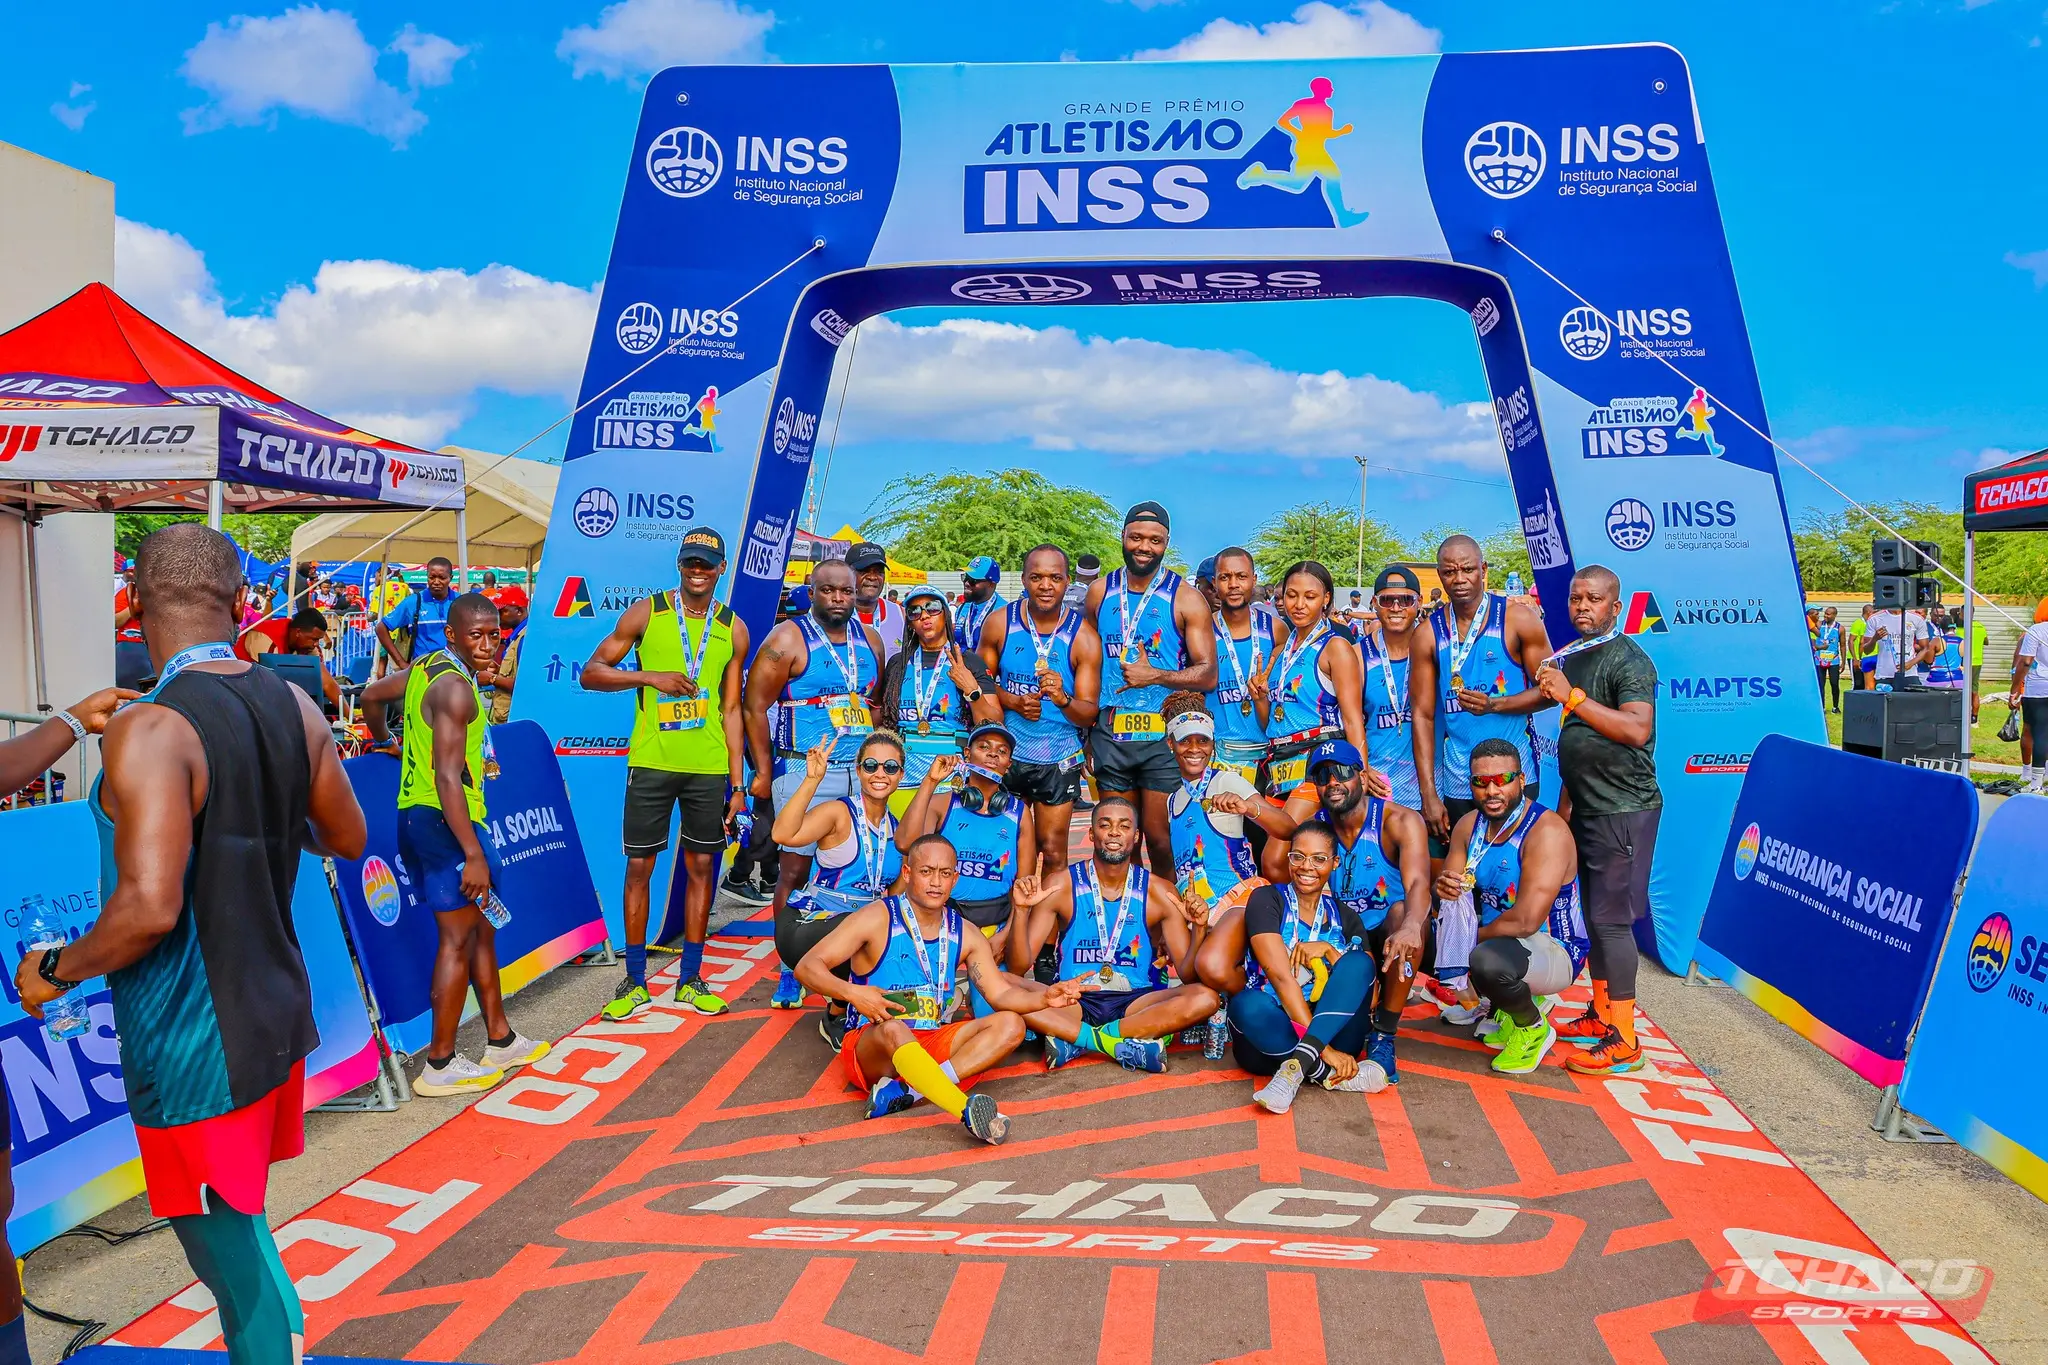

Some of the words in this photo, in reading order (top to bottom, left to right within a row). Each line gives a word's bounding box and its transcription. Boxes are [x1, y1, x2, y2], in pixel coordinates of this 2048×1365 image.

[1064, 101, 1152, 115] GRANDE
[1165, 98, 1245, 113] PRÊMIO
[985, 118, 1243, 156] ATLETISMO
[1560, 123, 1679, 164] INSS
[735, 136, 848, 175] INSS
[735, 176, 786, 191] Instituto
[790, 178, 846, 192] Nacional
[1559, 170, 1614, 181] Instituto
[1618, 168, 1678, 180] Nacional
[733, 191, 749, 202] de
[754, 192, 821, 208] Segurança
[825, 189, 863, 204] Social
[984, 165, 1209, 226] INSS
[1558, 184, 1575, 195] de
[1579, 183, 1652, 197] Segurança
[1656, 181, 1697, 192] Social
[1112, 271, 1321, 290] INSS
[670, 308, 739, 337] INSS
[1616, 308, 1692, 336] INSS
[668, 337, 699, 347] Instituto
[701, 338, 735, 349] Nacional
[1620, 340, 1654, 349] Instituto
[1656, 339, 1693, 347] Nacional
[678, 348, 720, 359] Segurança
[722, 350, 745, 360] Social
[1620, 349, 1632, 358] de
[1634, 349, 1679, 360] Segurança
[1681, 348, 1705, 357] Social
[661, 392, 688, 402] PRÊMIO
[1507, 386, 1529, 424] INSS
[1647, 397, 1676, 406] PRÊMIO
[604, 399, 688, 417] ATLETISMO
[1587, 406, 1678, 425] ATLETISMO
[47, 425, 195, 446] TCHACO
[601, 421, 675, 448] INSS
[792, 410, 817, 442] INSS
[1588, 429, 1668, 455] INSS
[237, 427, 377, 485] TCHACO
[409, 464, 458, 483] TCHACO
[625, 493, 695, 521] INSS
[1662, 500, 1736, 528] INSS
[625, 522, 656, 531] Instituto
[658, 523, 694, 533] Nacional
[625, 531, 636, 539] de
[638, 531, 679, 542] Segurança
[1664, 532, 1698, 541] Instituto
[1700, 531, 1738, 540] Nacional
[1528, 537, 1552, 566] INSS
[1678, 541, 1721, 551] Segurança
[1723, 540, 1750, 548] Social
[745, 542, 774, 576] INSS
[605, 586, 663, 595] GOVERNO
[1675, 599, 1739, 607] GOVERNO
[1673, 608, 1768, 624] ANGOLA
[1671, 677, 1782, 699] MAPTSS
[673, 702, 699, 720] 631
[843, 708, 864, 724] 680
[1125, 714, 1151, 731] 689
[563, 737, 629, 747] TCHACO
[1692, 754, 1751, 765] TCHAC
[1277, 764, 1293, 781] 567
[505, 807, 563, 843] SOCIAL
[501, 859, 509, 867] DE
[511, 844, 544, 863] SEGURANÇA
[546, 841, 566, 851] SOCIAL
[1759, 835, 1852, 903] SEGURANÇA
[1853, 876, 1924, 932] SOCIAL
[4, 890, 98, 929] GNDE
[1755, 870, 1769, 886] INSS
[1770, 880, 1799, 899] INSTITUTO
[1800, 894, 1830, 915] NACIONAL
[1832, 910, 1841, 921] DE
[1842, 916, 1882, 940] SEGURANÇA
[1884, 934, 1912, 953] SOCIAL
[2008, 983, 2035, 1008] INSS
[688, 1174, 1521, 1238] TCHACO
[750, 1226, 1382, 1261] SPORTS
